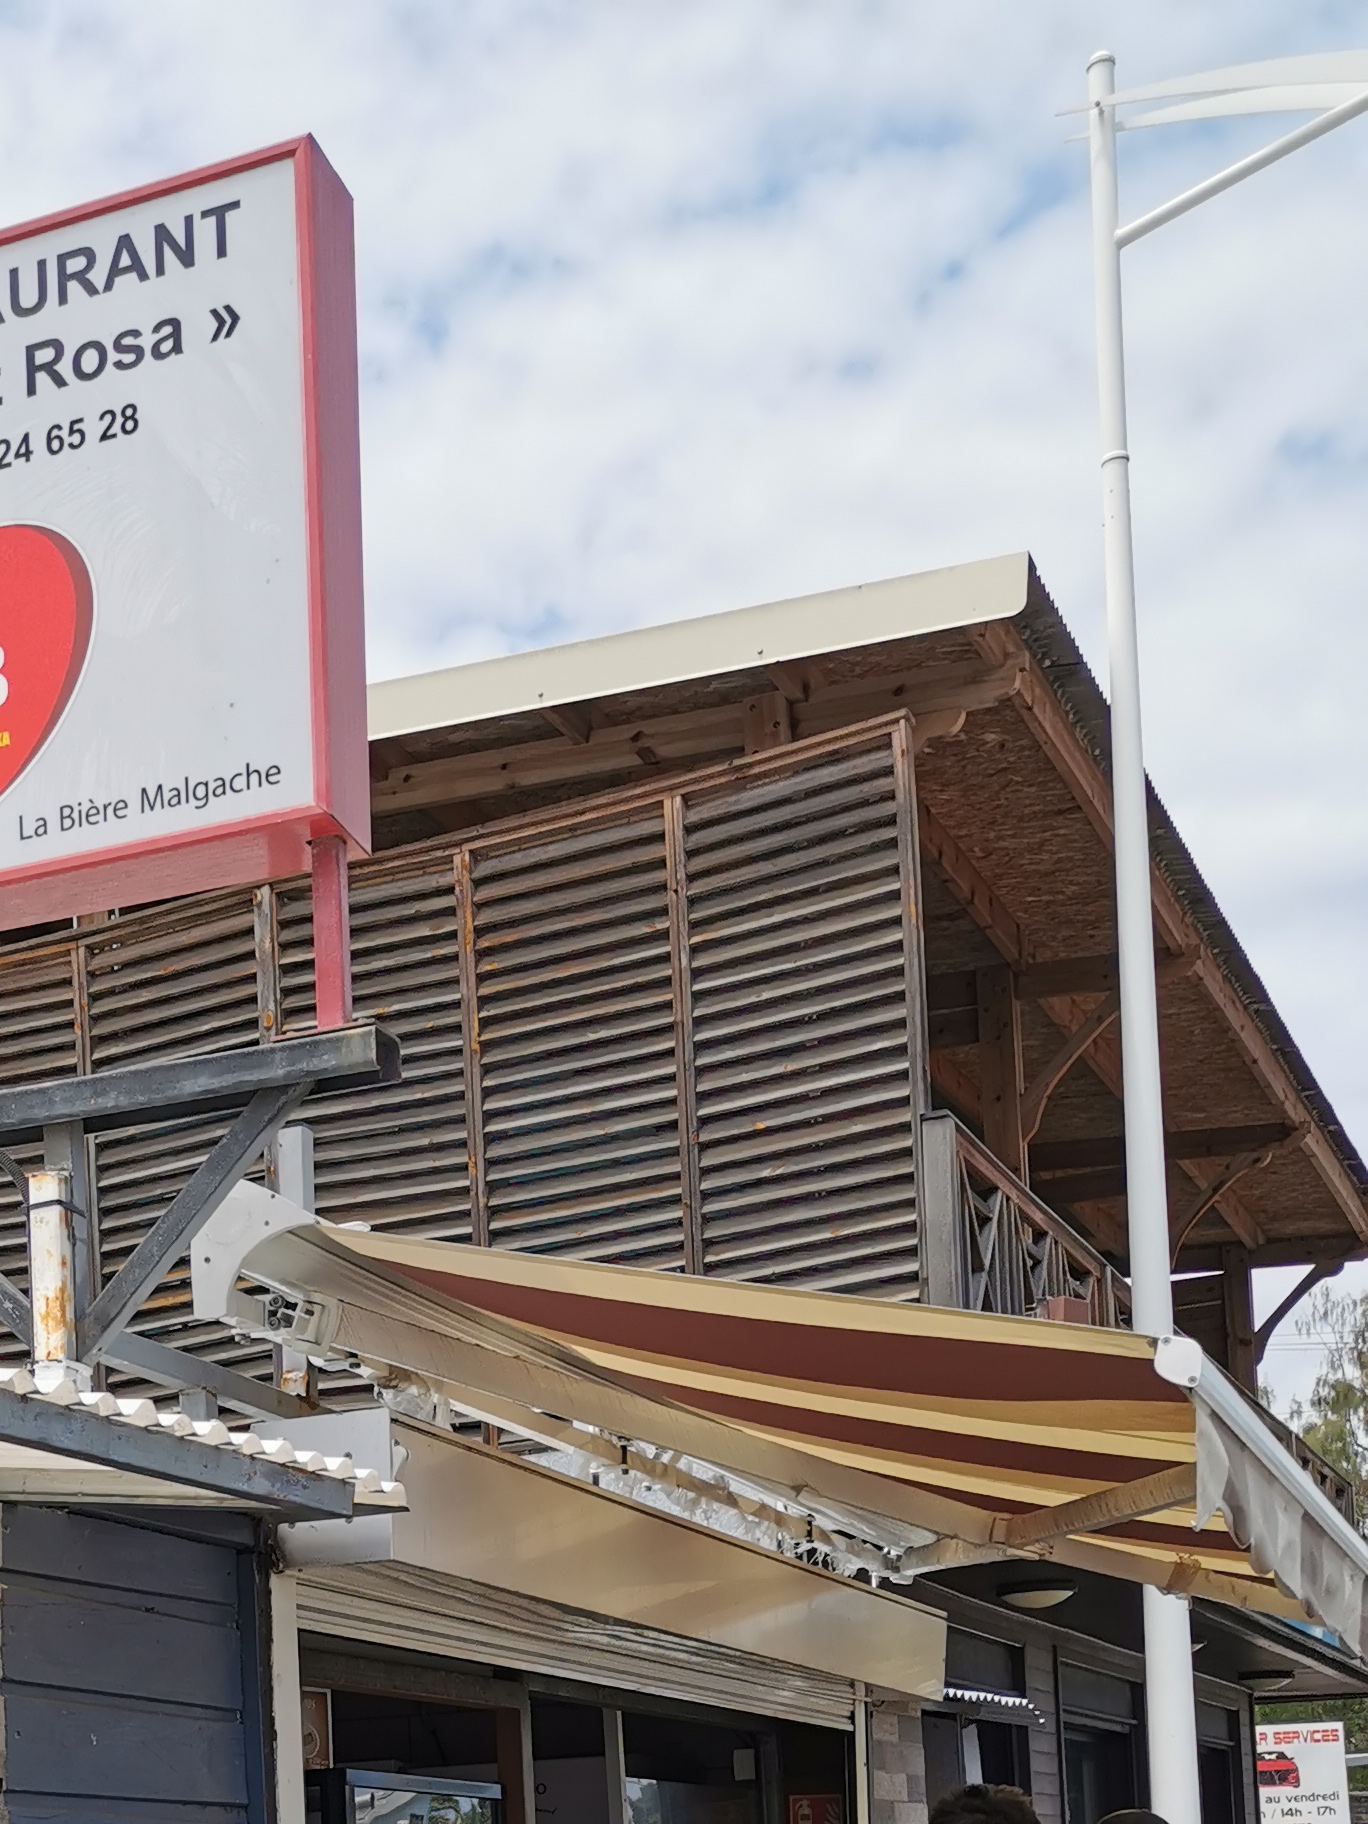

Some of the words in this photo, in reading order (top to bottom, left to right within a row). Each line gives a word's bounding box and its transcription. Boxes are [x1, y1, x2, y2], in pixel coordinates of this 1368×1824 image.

[25, 316, 184, 397] Rosa
[45, 417, 86, 458] 65
[98, 403, 140, 445] 28
[19, 797, 49, 841] La
[58, 792, 129, 834] Bière
[140, 761, 282, 816] Malgache
[1273, 1729, 1340, 1745] SERVICES
[1265, 1795, 1281, 1804] au
[1285, 1790, 1340, 1804] vendredi
[1281, 1807, 1303, 1818] 14h
[1317, 1806, 1337, 1816] 17h
